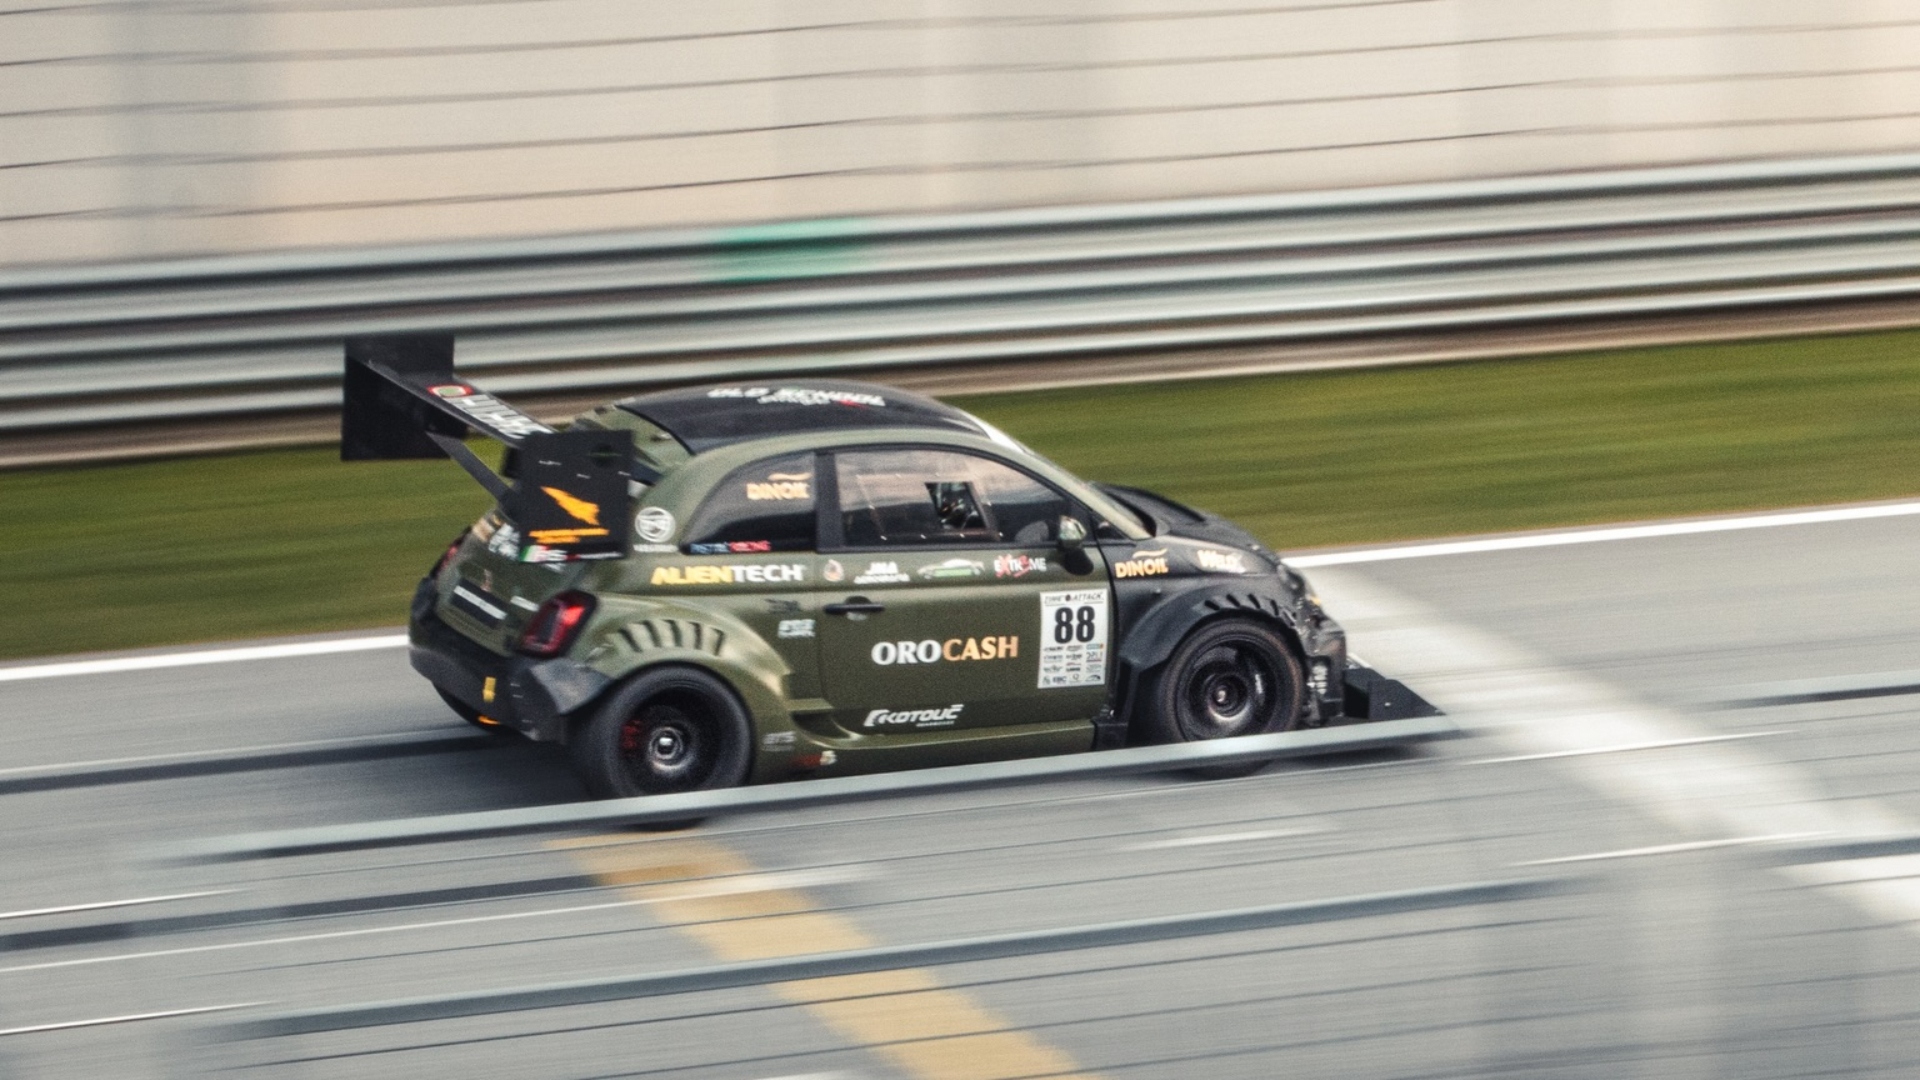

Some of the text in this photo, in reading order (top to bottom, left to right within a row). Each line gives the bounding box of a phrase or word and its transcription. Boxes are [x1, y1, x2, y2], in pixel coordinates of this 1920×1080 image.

[651, 564, 805, 585] ALIENTECH
[1115, 558, 1168, 578] DINOIL
[1054, 605, 1096, 644] 88
[871, 636, 1020, 666] OROCASH
